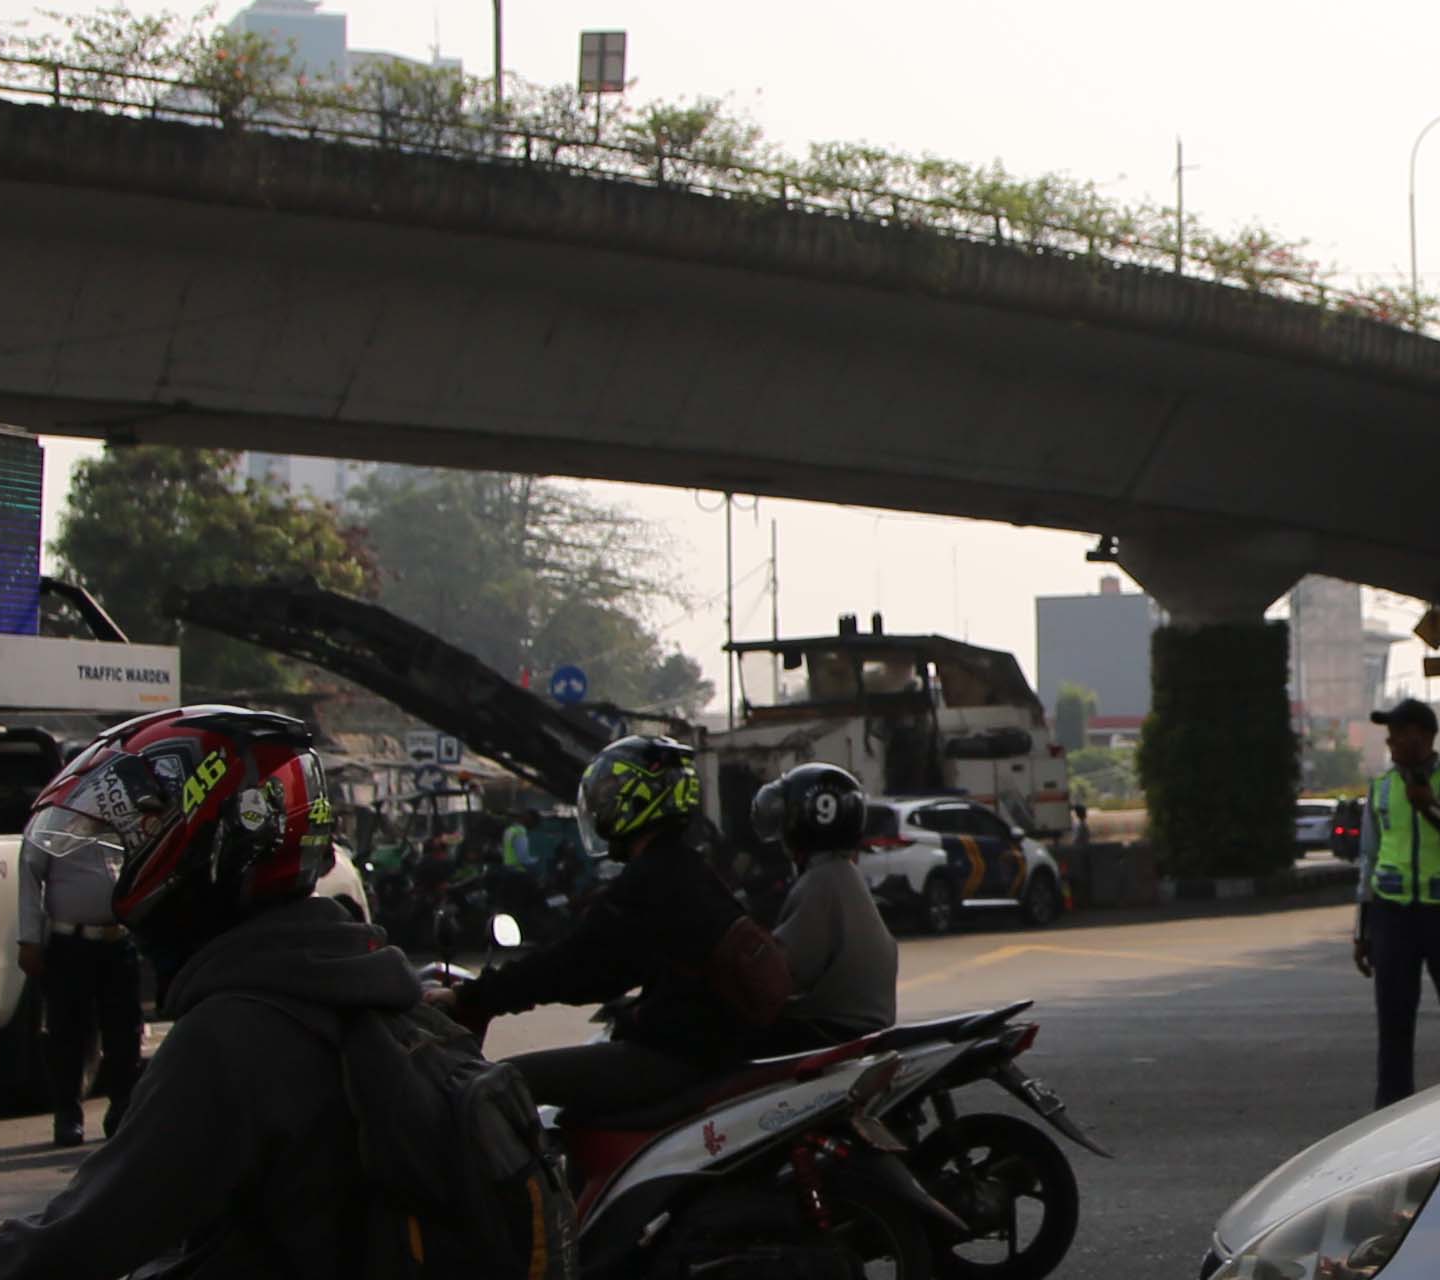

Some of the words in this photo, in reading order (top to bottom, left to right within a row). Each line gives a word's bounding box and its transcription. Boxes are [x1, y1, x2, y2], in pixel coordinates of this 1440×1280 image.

[77, 664, 123, 683] TRAFFIC
[126, 667, 170, 685] WARDEN
[182, 750, 228, 814] 46
[816, 793, 838, 824] 9
